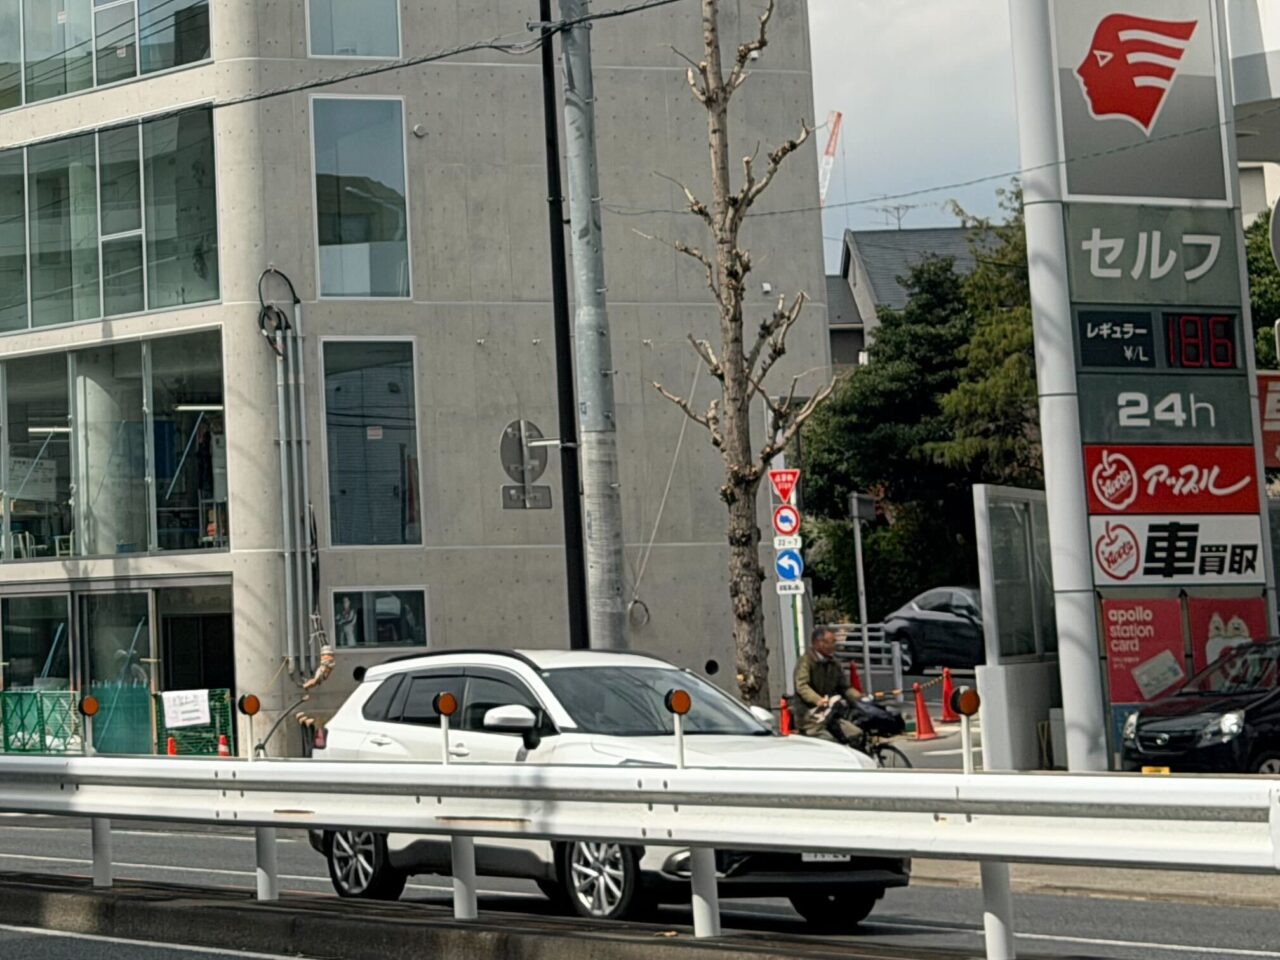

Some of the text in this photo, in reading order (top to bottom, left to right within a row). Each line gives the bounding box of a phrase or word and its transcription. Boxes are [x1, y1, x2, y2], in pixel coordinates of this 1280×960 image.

[1081, 228, 1221, 280] セルフ
[1086, 322, 1148, 339] レギュラー
[1169, 316, 1233, 367] 186
[1117, 392, 1216, 428] 24h
[1143, 464, 1252, 496] アップル
[1143, 521, 1258, 578] 車買取
[1108, 606, 1153, 625] apollo
[1109, 624, 1154, 638] station
[1111, 638, 1139, 652] card
